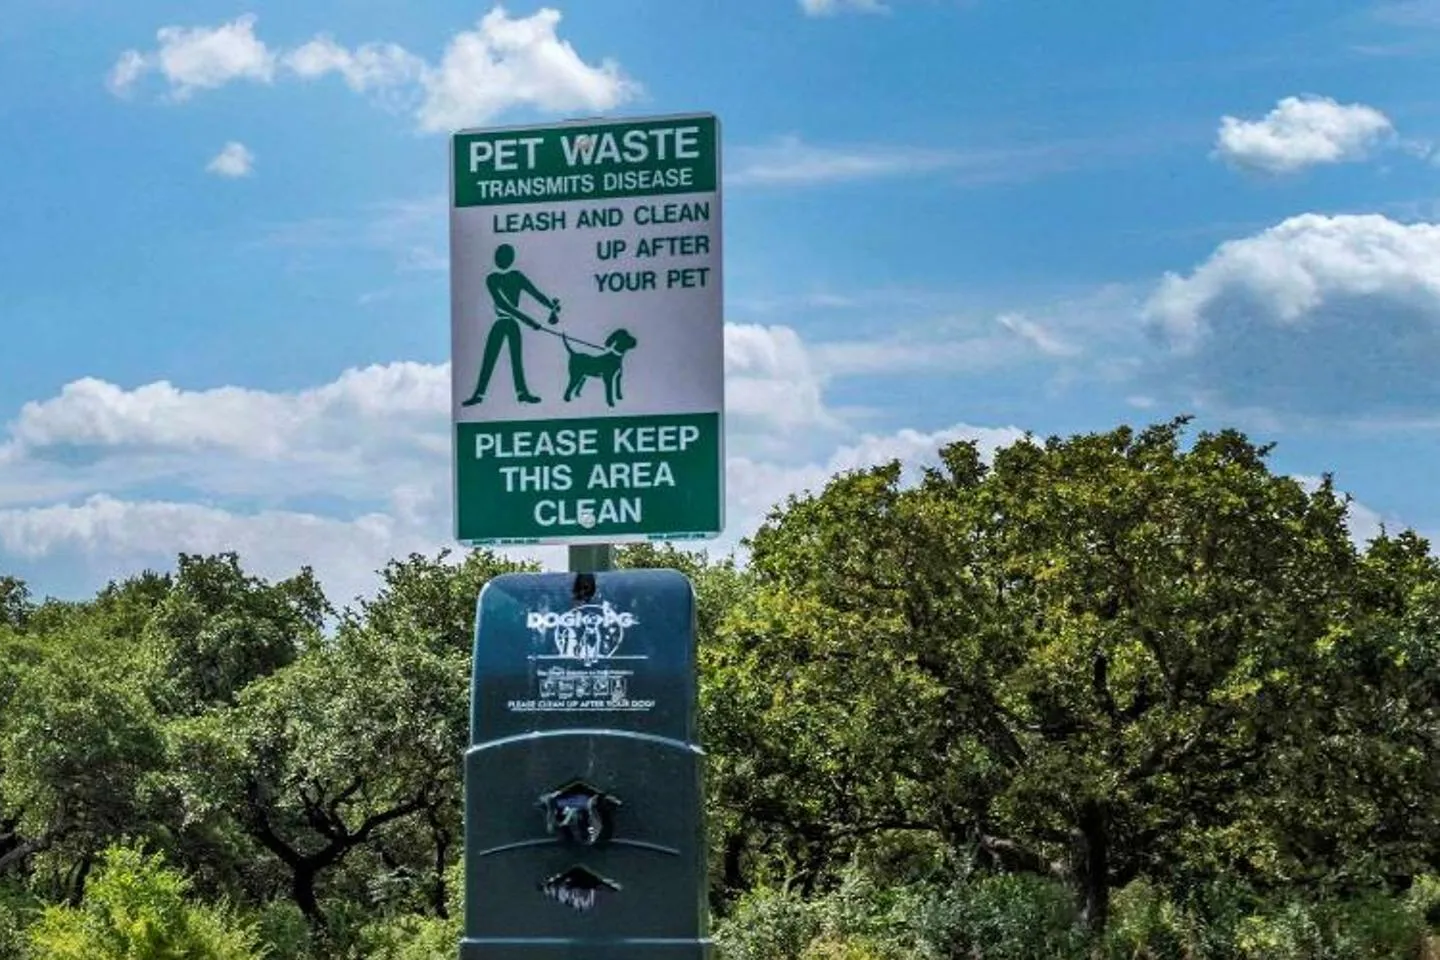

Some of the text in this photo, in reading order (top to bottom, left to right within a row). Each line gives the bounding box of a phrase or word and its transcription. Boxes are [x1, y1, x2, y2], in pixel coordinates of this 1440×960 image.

[469, 126, 700, 172] PET WASTE
[477, 168, 693, 199] TRANSMITS DISEASE
[493, 203, 710, 233] LEASH AND CLEAN
[596, 236, 710, 260] UP AFTER
[594, 268, 710, 293] YOUR PET
[475, 425, 699, 459] PLEASE KEEP
[499, 461, 675, 492] THIS AREA
[533, 497, 642, 526] CLEAN
